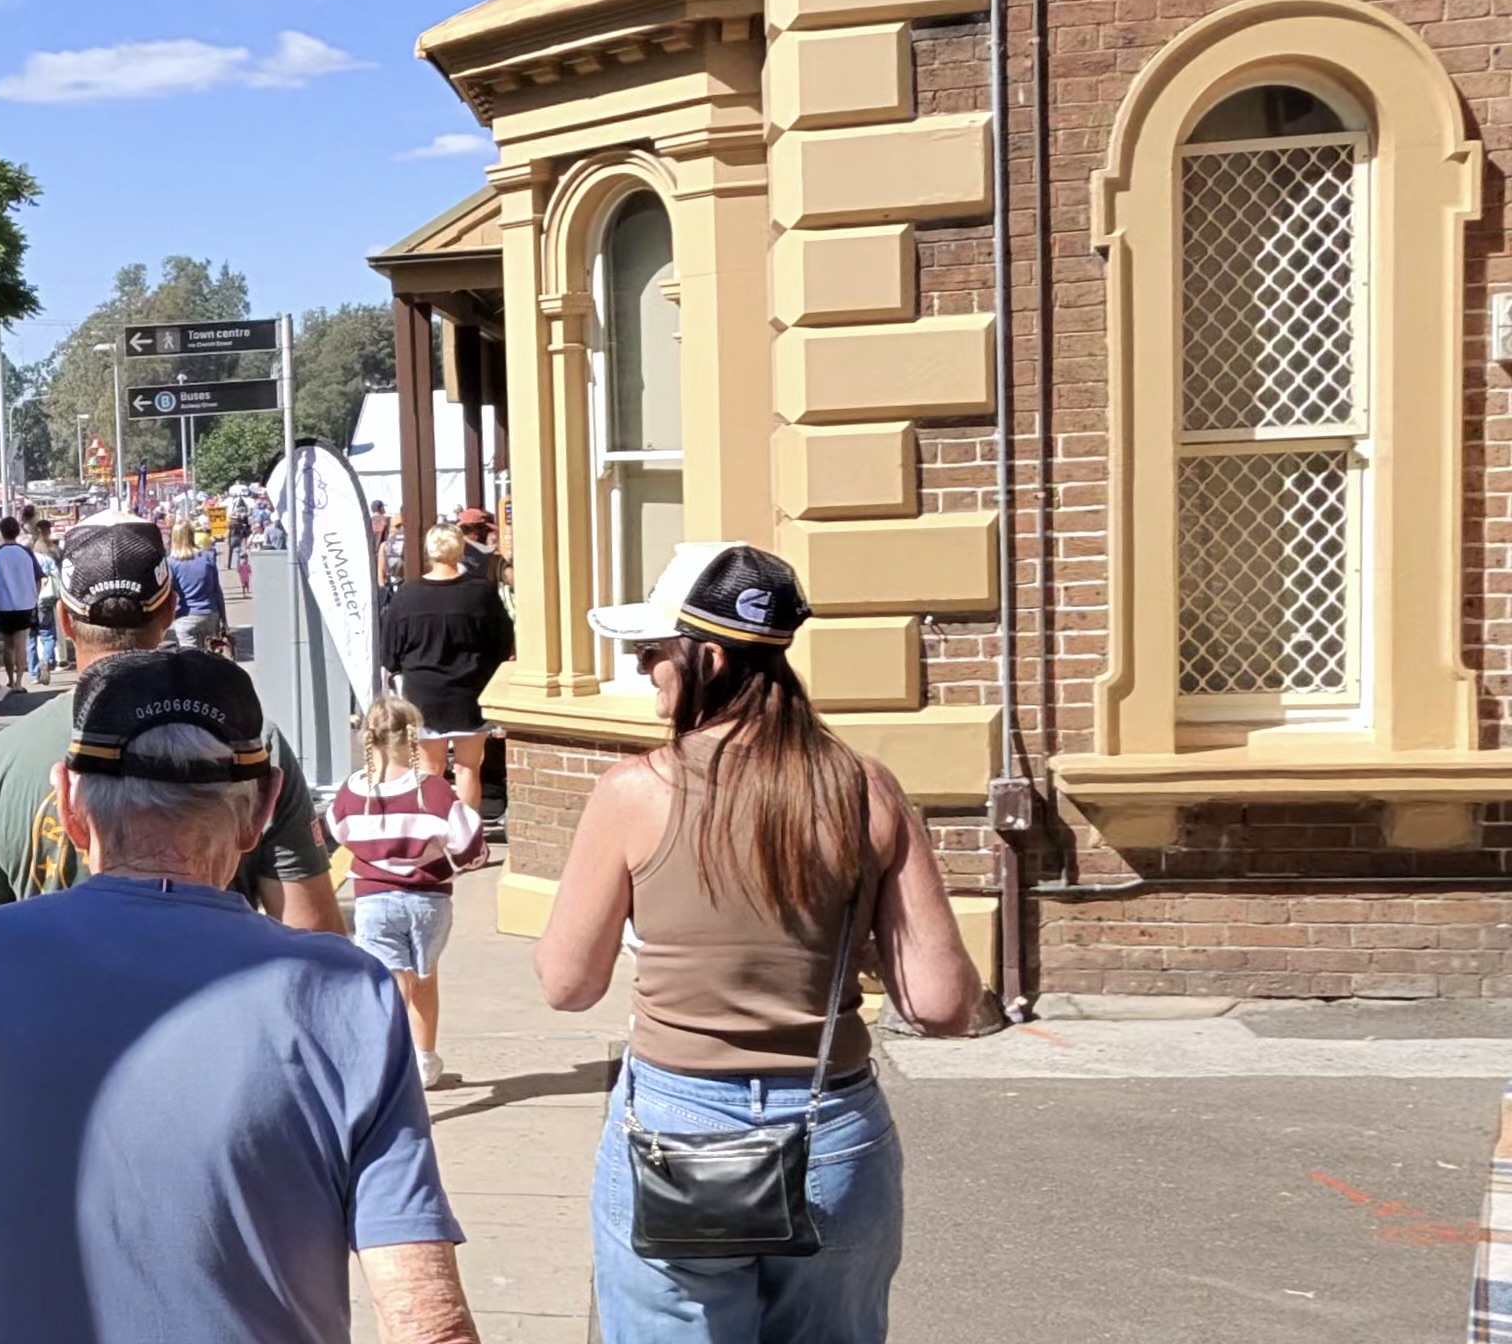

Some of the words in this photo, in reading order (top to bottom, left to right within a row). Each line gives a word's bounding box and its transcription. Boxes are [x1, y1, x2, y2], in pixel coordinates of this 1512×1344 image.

[188, 330, 215, 340] Town
[216, 328, 251, 338] centre
[180, 391, 211, 401] Buses
[321, 555, 342, 607] Awareness
